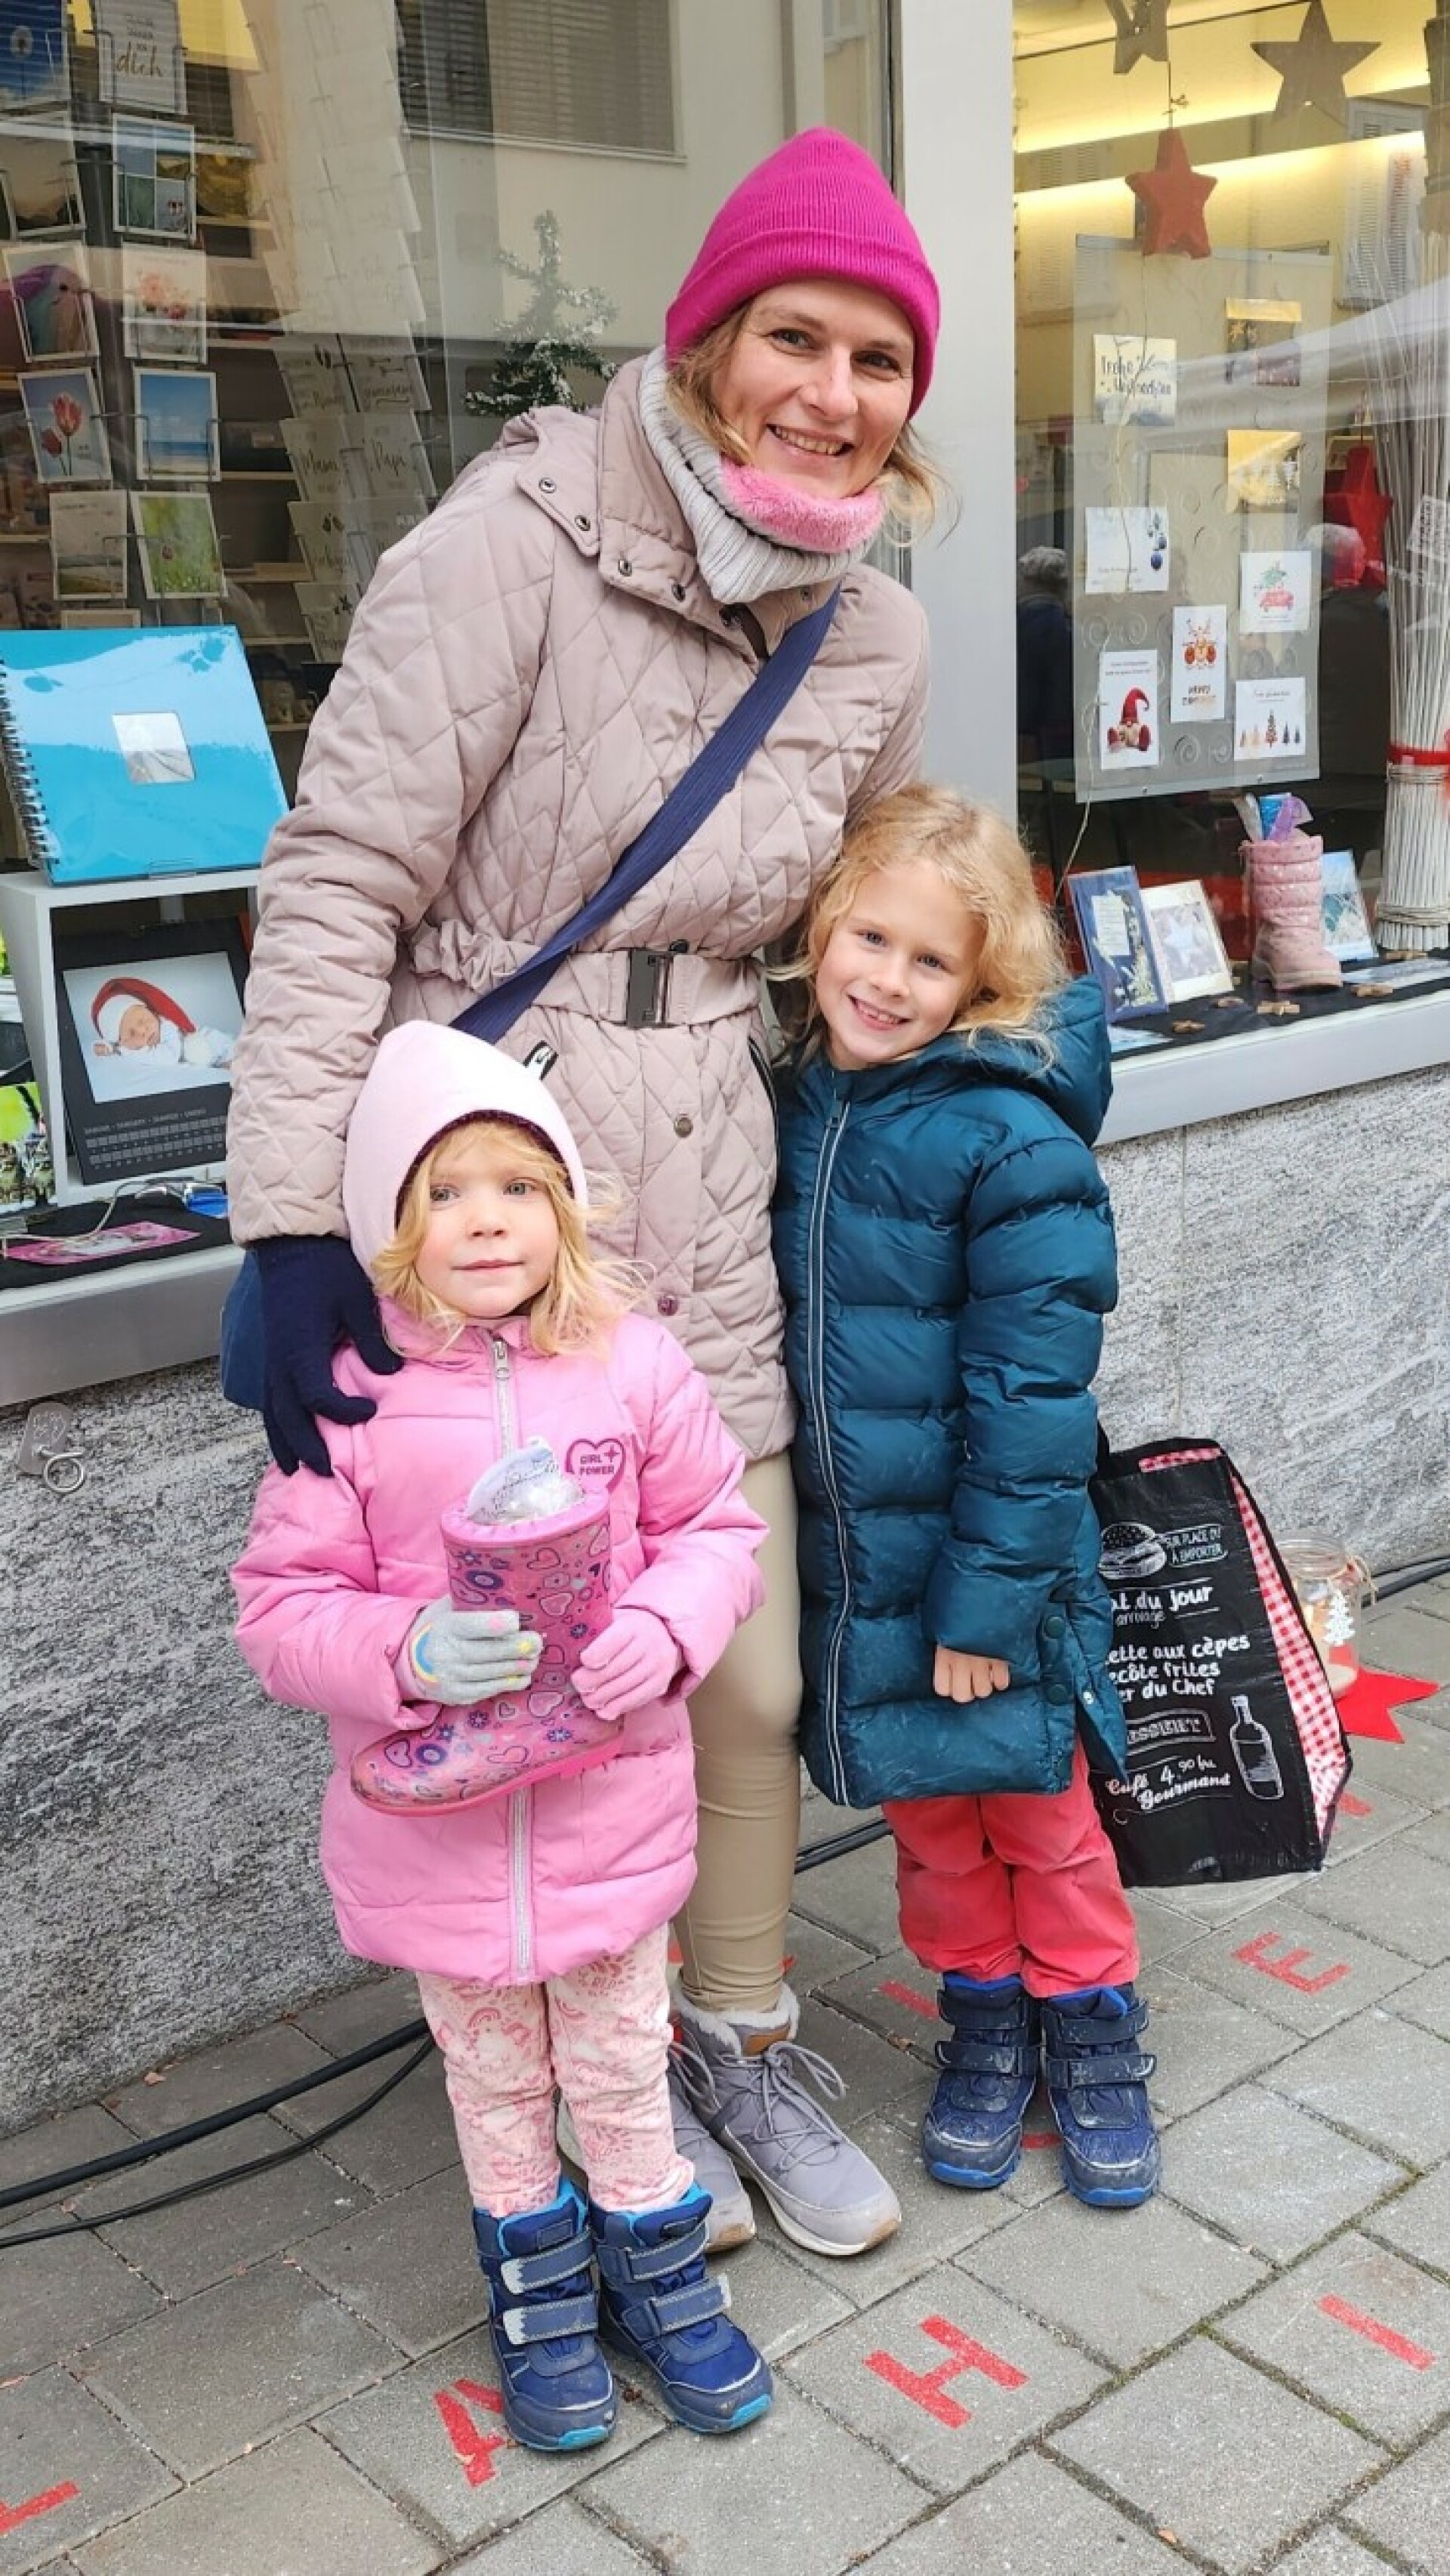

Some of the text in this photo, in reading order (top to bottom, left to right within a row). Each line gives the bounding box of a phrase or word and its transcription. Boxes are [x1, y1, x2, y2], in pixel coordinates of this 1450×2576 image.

[579, 1465, 615, 1476] POWER
[580, 1453, 602, 1465] GIRL
[1135, 1590, 1163, 1611] du
[1169, 1586, 1214, 1611] jour
[1105, 1634, 1251, 1665] ette aux cèpes
[1163, 1660, 1221, 1678] frites
[1141, 1679, 1168, 1699] du
[1172, 1678, 1215, 1696] Chef
[1105, 1773, 1149, 1798] Café
[1137, 1772, 1231, 1810] Gourmand
[1232, 1931, 1353, 1995] E
[862, 2314, 1031, 2429] H
